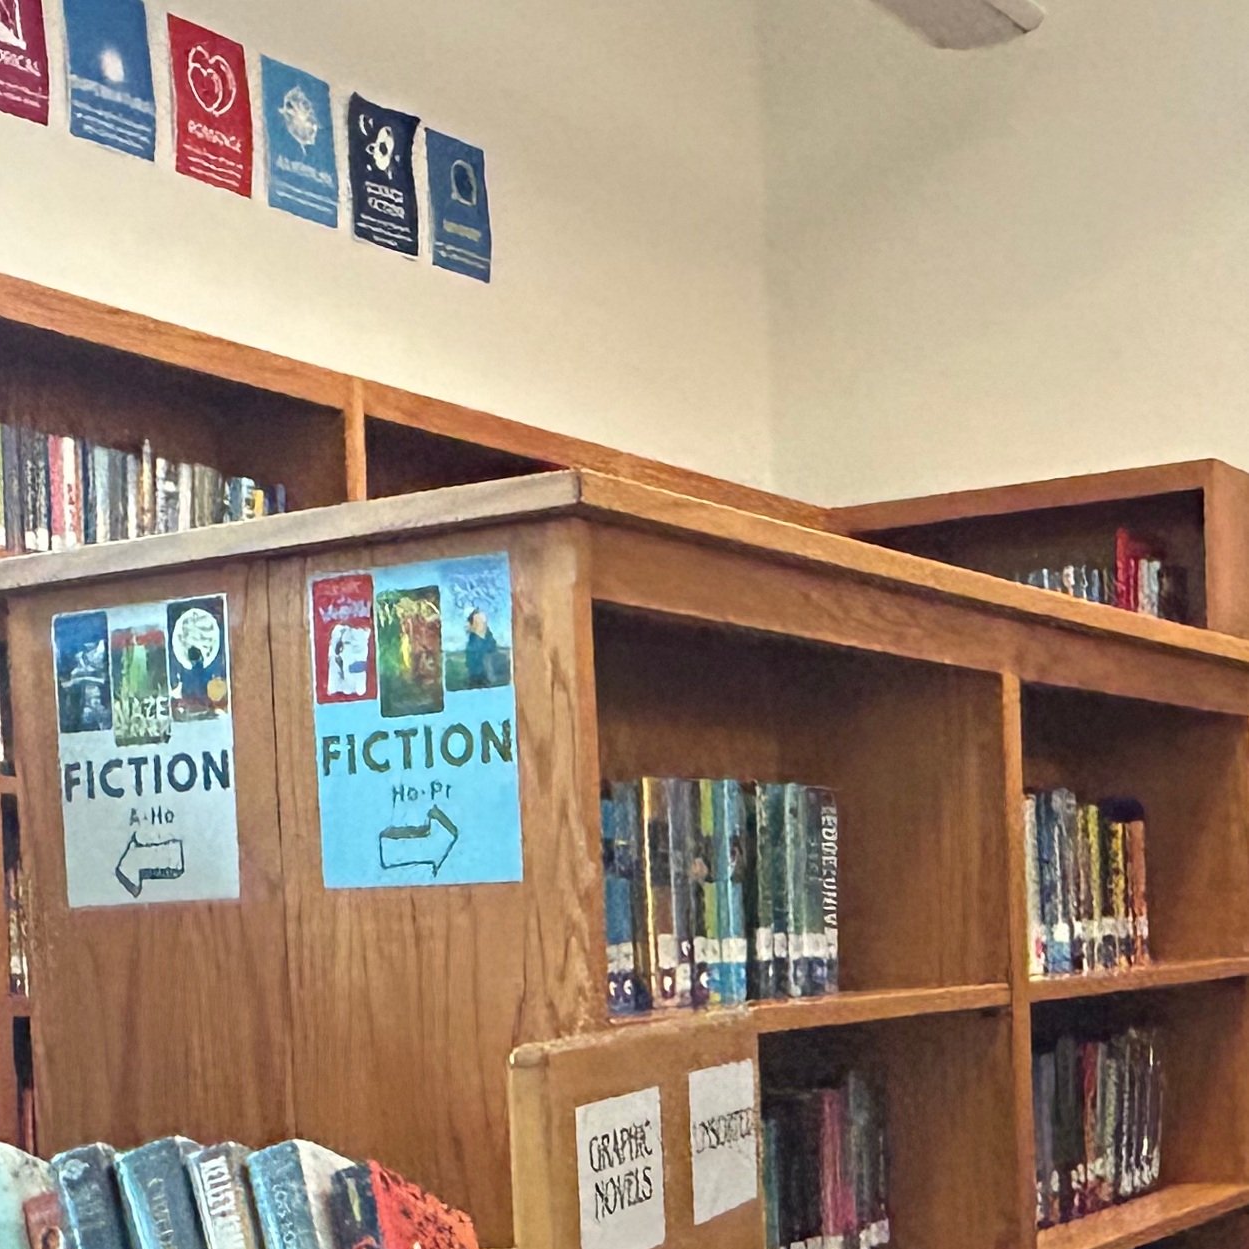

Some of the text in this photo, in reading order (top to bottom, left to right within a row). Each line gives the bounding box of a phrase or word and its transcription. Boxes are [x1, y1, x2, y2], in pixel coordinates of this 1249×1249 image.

[322, 718, 513, 776] FICTION
[64, 749, 230, 802] FICTION
[589, 1119, 653, 1173] GRAPHIC
[594, 1166, 653, 1223] NOVELS
